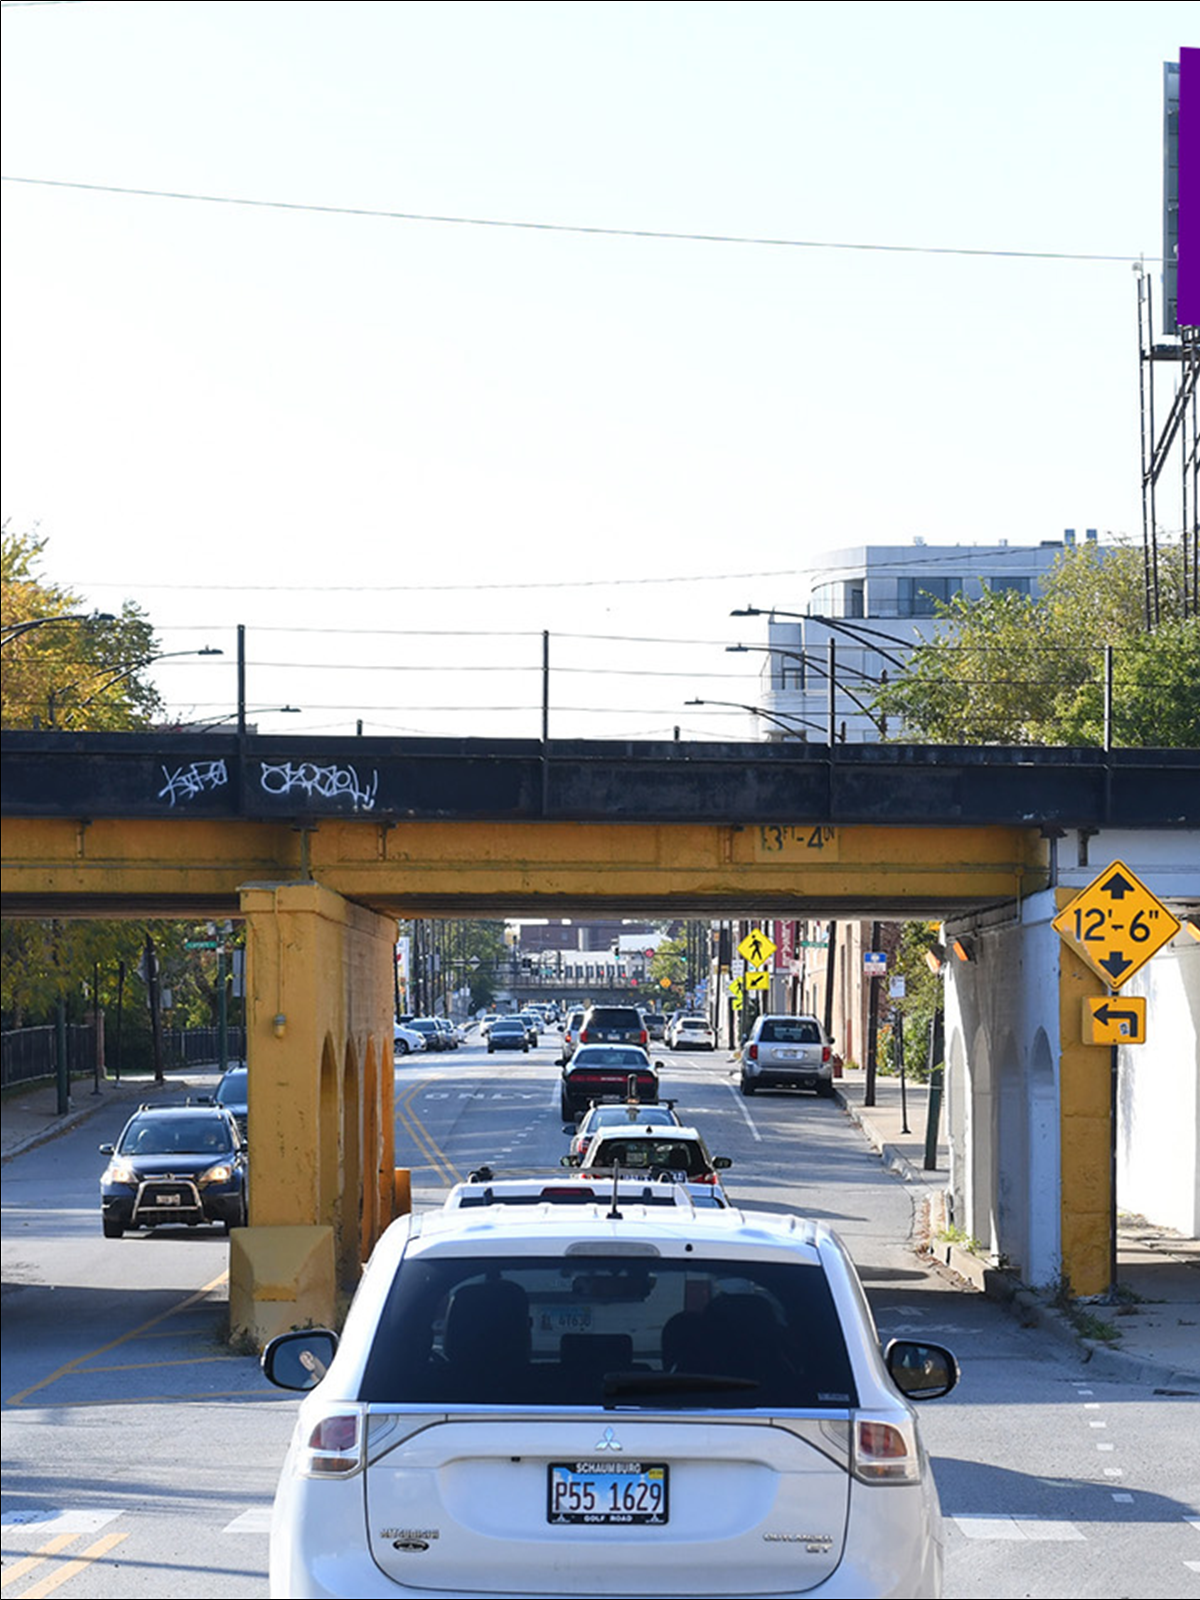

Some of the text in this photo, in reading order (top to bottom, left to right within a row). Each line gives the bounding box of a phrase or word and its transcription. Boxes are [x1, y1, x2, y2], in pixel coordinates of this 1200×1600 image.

[576, 1462, 642, 1474] SCHAUMBURG
[555, 1481, 662, 1511] P55 1629
